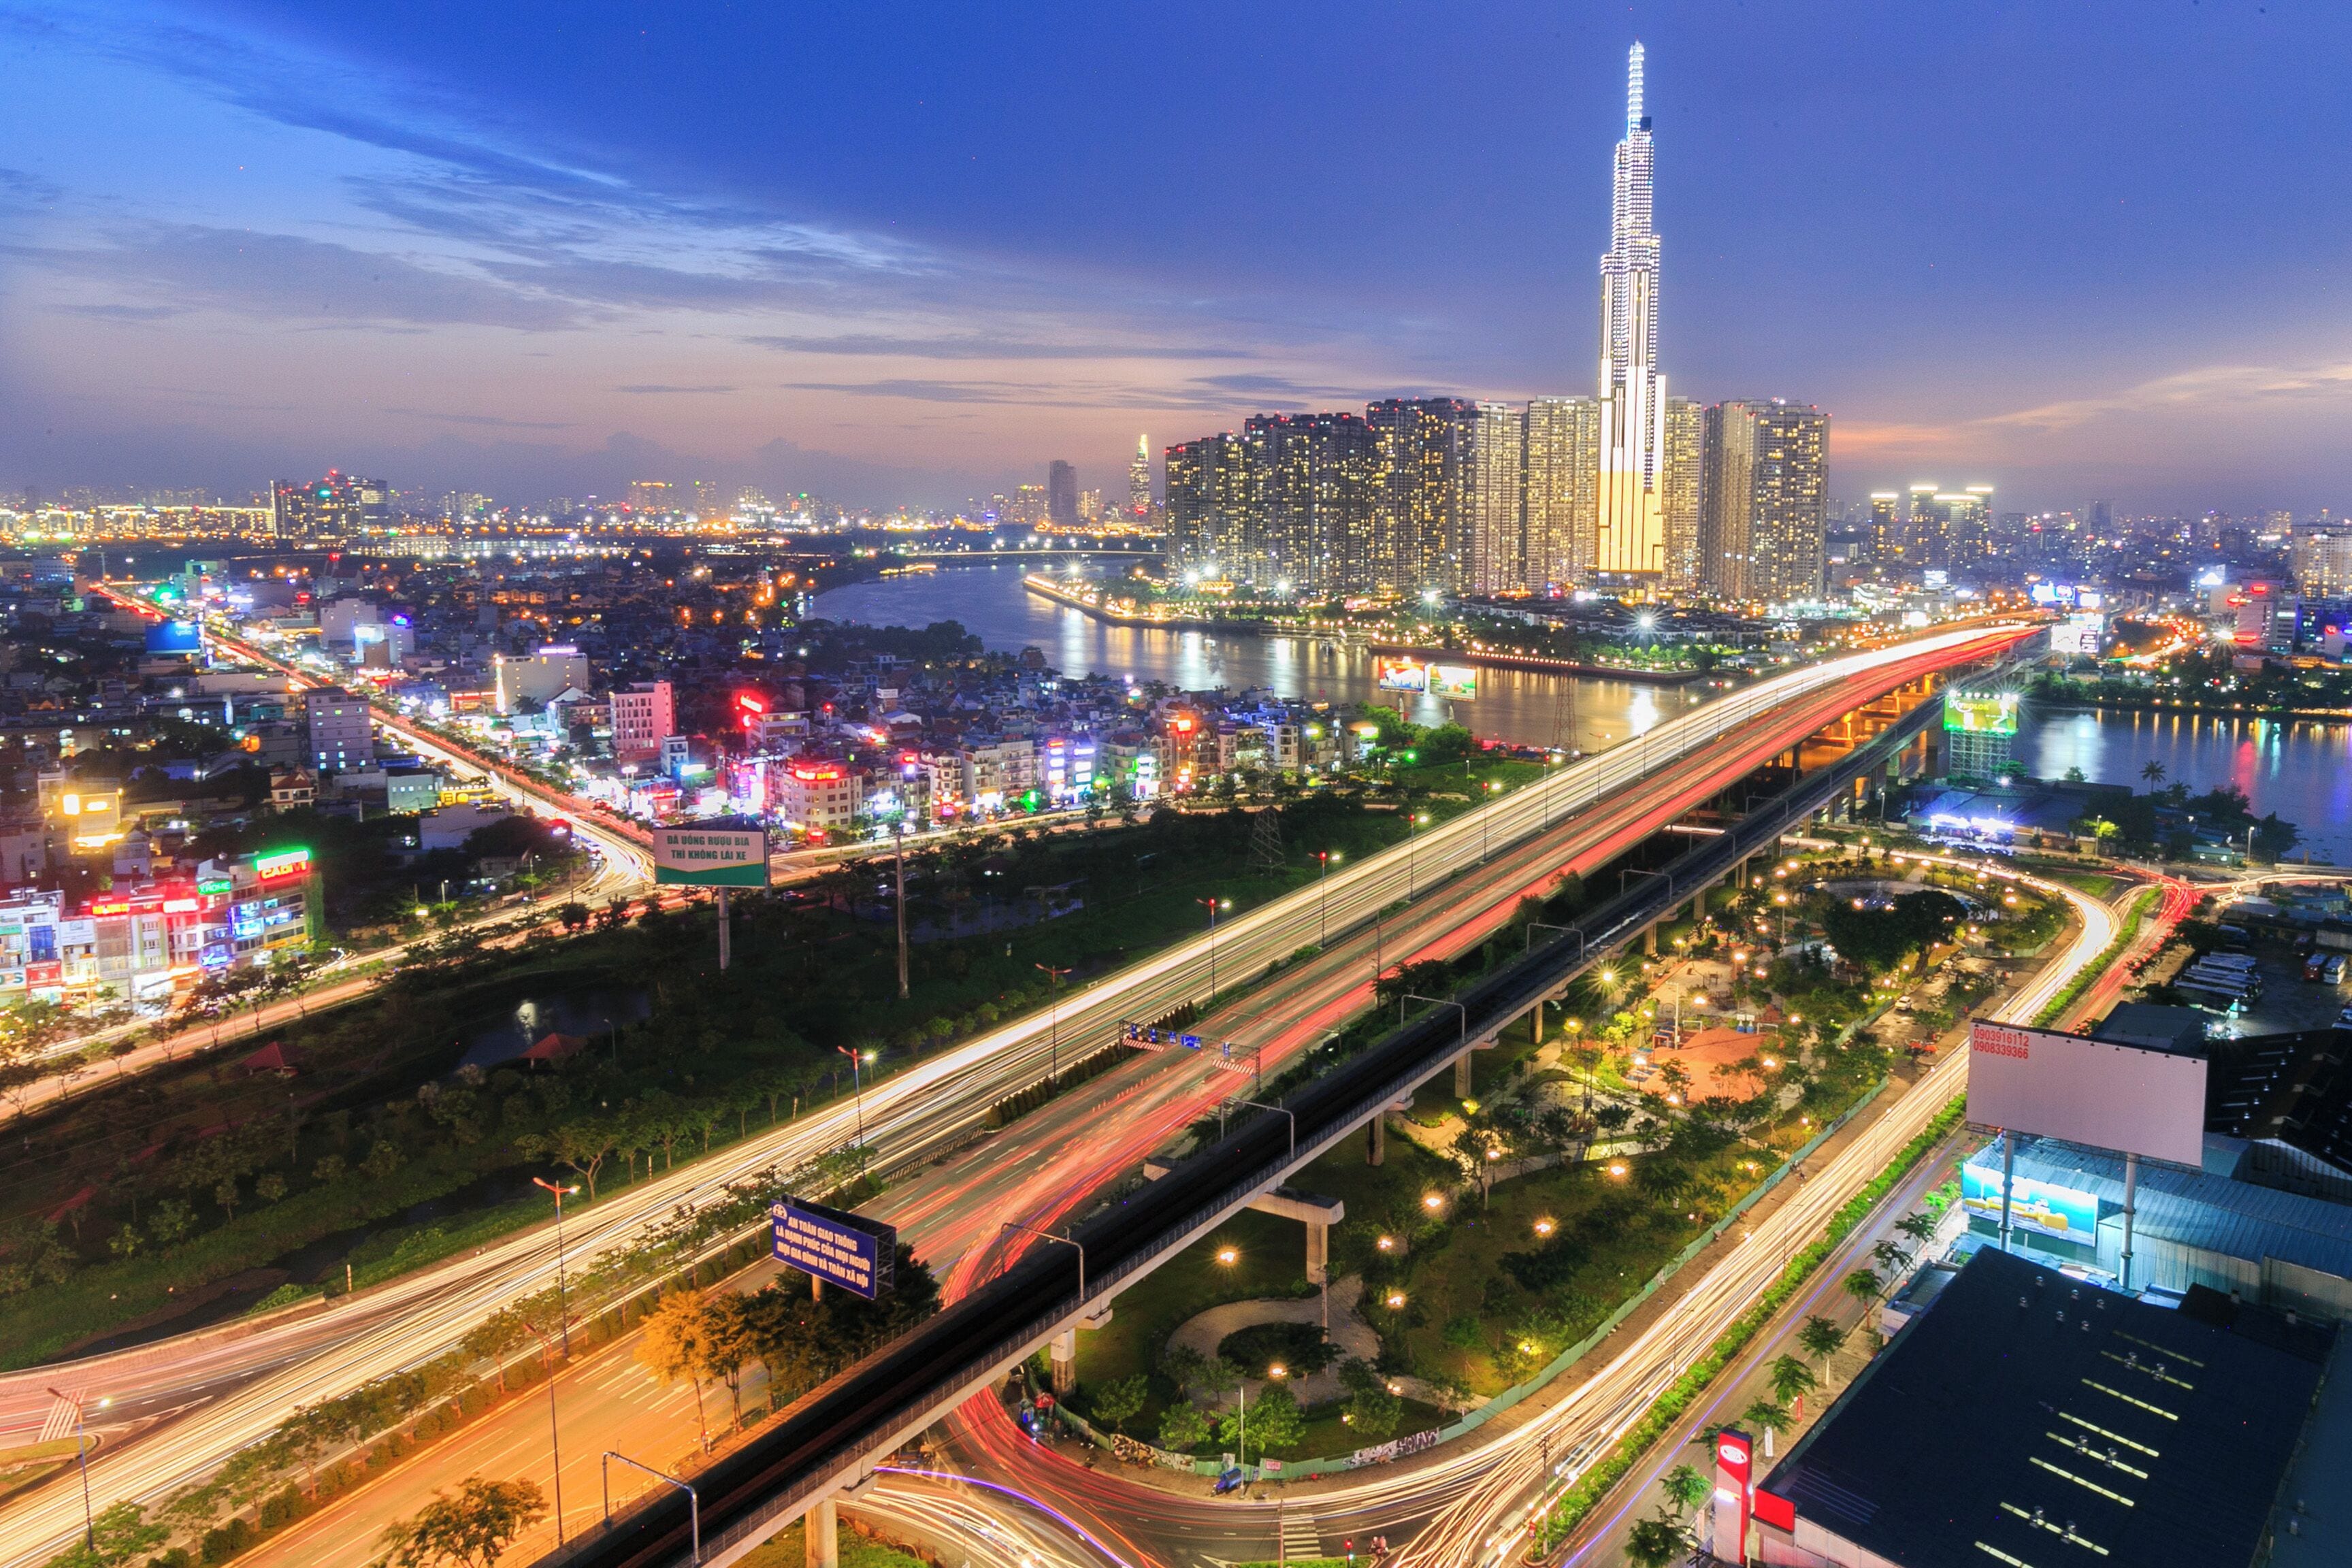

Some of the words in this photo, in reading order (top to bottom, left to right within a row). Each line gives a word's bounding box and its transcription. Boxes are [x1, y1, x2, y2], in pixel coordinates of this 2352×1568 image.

[681, 834, 705, 845] UỐNG
[708, 836, 732, 847] RƯỢU
[735, 837, 750, 846] BIA
[672, 849, 685, 859] THÌ
[688, 849, 717, 860] KHÔNG
[721, 850, 733, 860] LÁI
[736, 851, 747, 860] XE
[1974, 1028, 2029, 1047] 0903916112
[1974, 1041, 2028, 1059] 0908339366
[788, 1216, 798, 1229] AN
[799, 1220, 817, 1236] TOÀN
[817, 1228, 834, 1242] GIAO
[834, 1234, 858, 1252] THÔNG
[776, 1225, 784, 1238] LÀ
[785, 1230, 802, 1244] HẠNH
[803, 1237, 820, 1252] PHÚC
[821, 1243, 834, 1257] CỦA
[835, 1249, 849, 1264] MỌI
[849, 1254, 870, 1271] NGƯỜI
[777, 1241, 790, 1256] MỌI
[791, 1247, 802, 1260] GIA
[802, 1252, 818, 1267] ĐÌNH
[819, 1258, 828, 1271] VÀ
[828, 1262, 845, 1278] TOÀN
[846, 1269, 855, 1282] XÃ
[856, 1274, 868, 1288] HỘI
